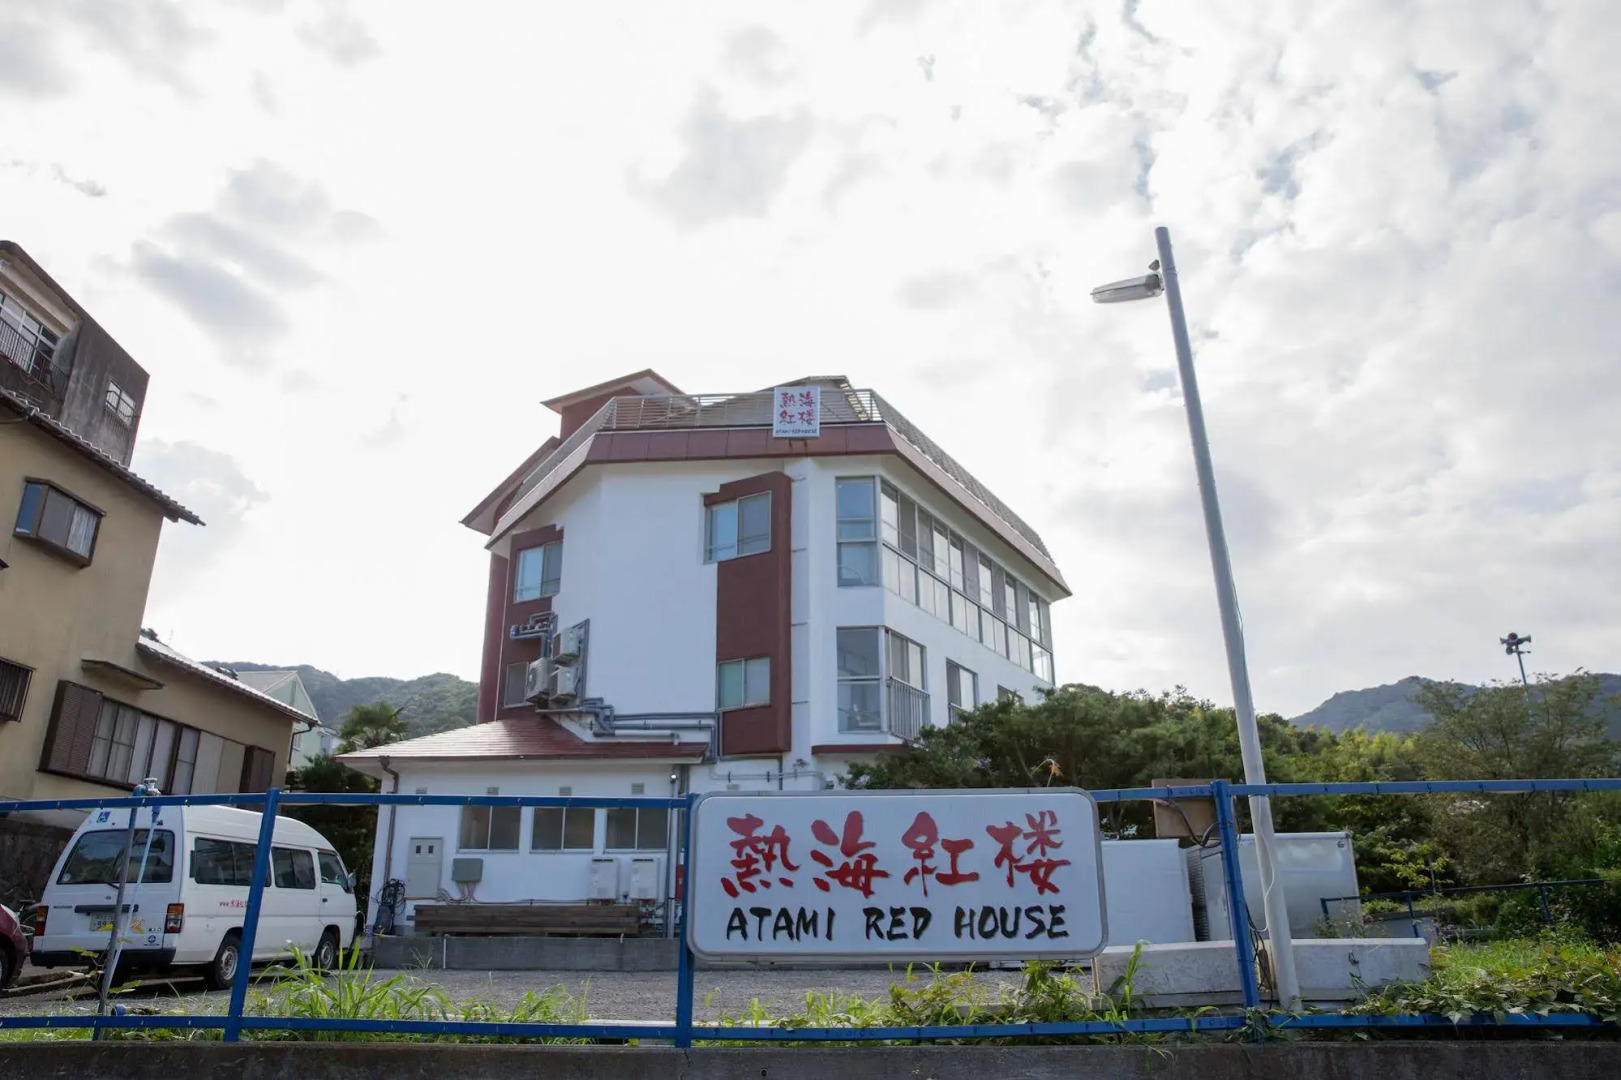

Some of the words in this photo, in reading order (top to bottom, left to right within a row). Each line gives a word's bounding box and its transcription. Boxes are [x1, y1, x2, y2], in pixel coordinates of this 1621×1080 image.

[780, 391, 815, 408] 熱海
[720, 810, 1072, 898] 熱海紅楼
[726, 906, 835, 941] ATAMI
[863, 906, 932, 941] RED
[954, 905, 1069, 941] HOUSE
